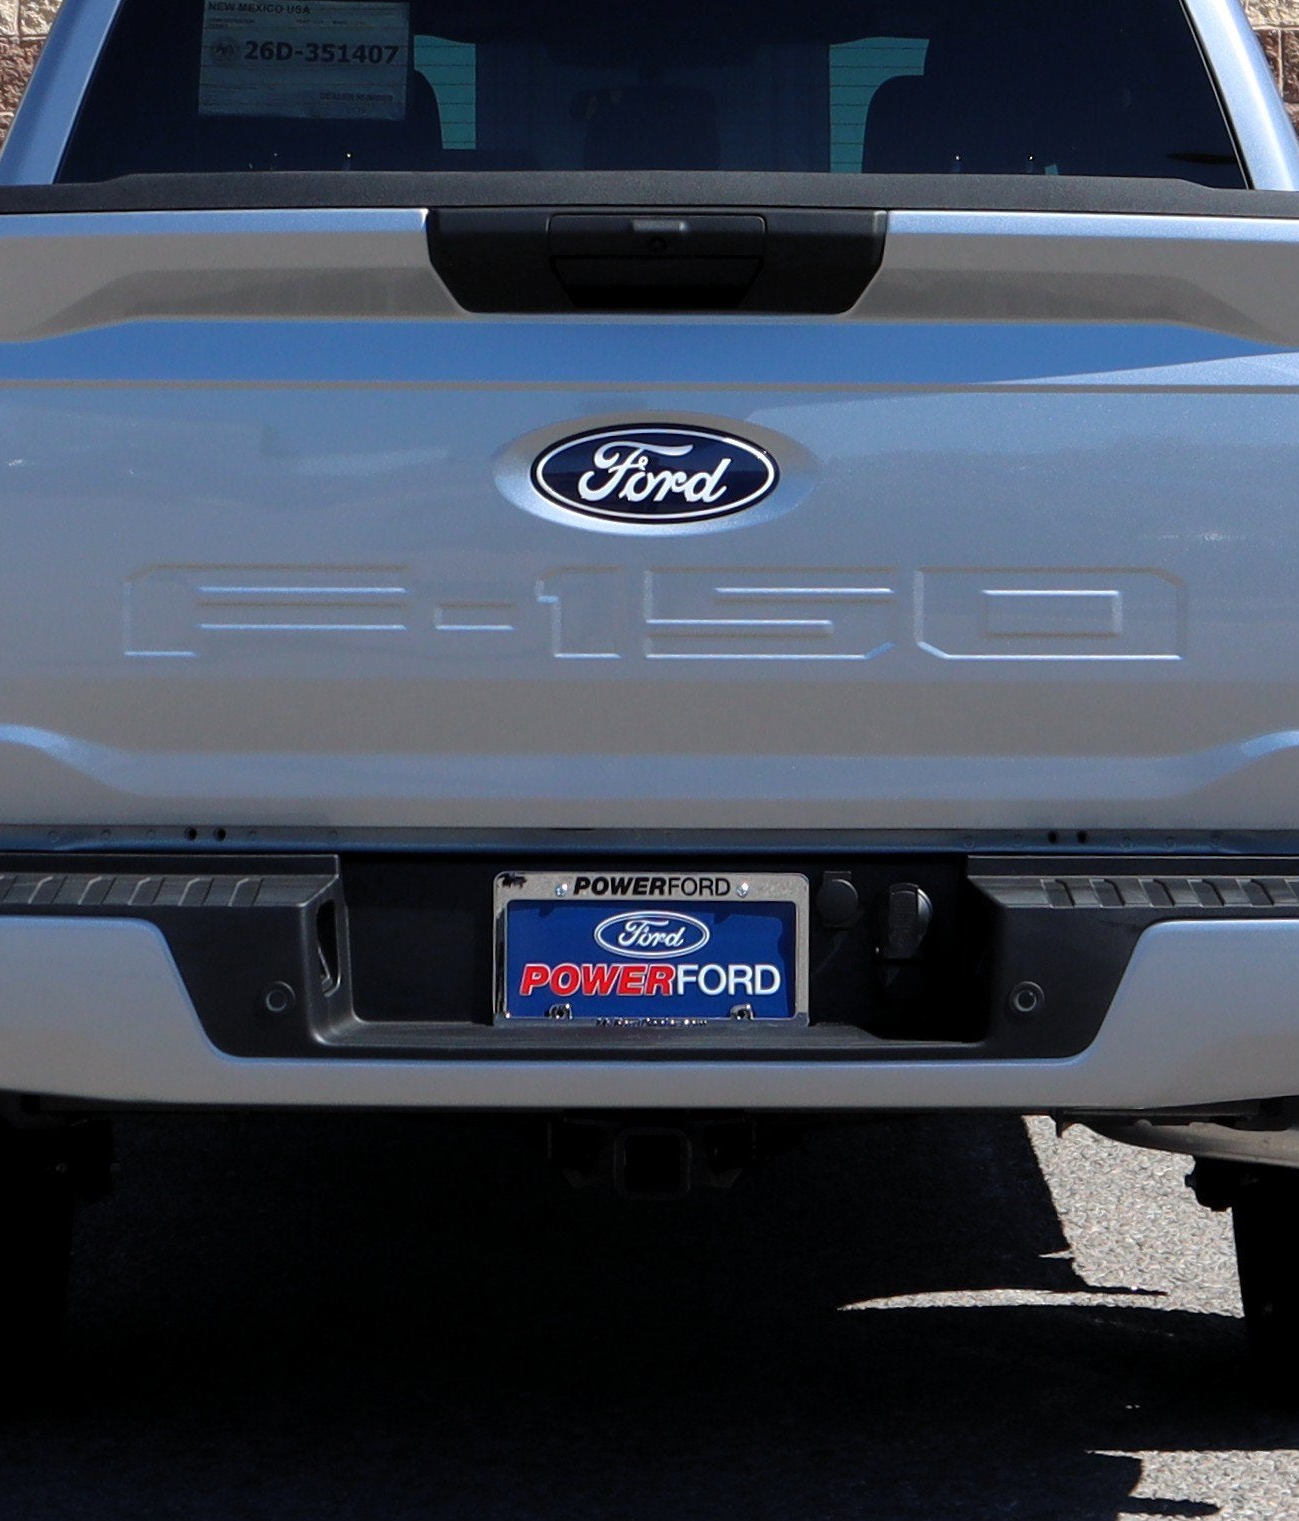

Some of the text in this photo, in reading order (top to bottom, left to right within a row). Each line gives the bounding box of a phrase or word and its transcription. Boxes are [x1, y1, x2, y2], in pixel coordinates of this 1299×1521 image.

[208, 2, 311, 15] NEW MEXICO USA
[245, 40, 399, 65] 26D-351407
[577, 441, 727, 506] Ford
[123, 563, 1186, 661] F-150
[573, 877, 731, 897] POWERFORD
[618, 919, 685, 948] Ford
[519, 963, 782, 996] POWERFORD
